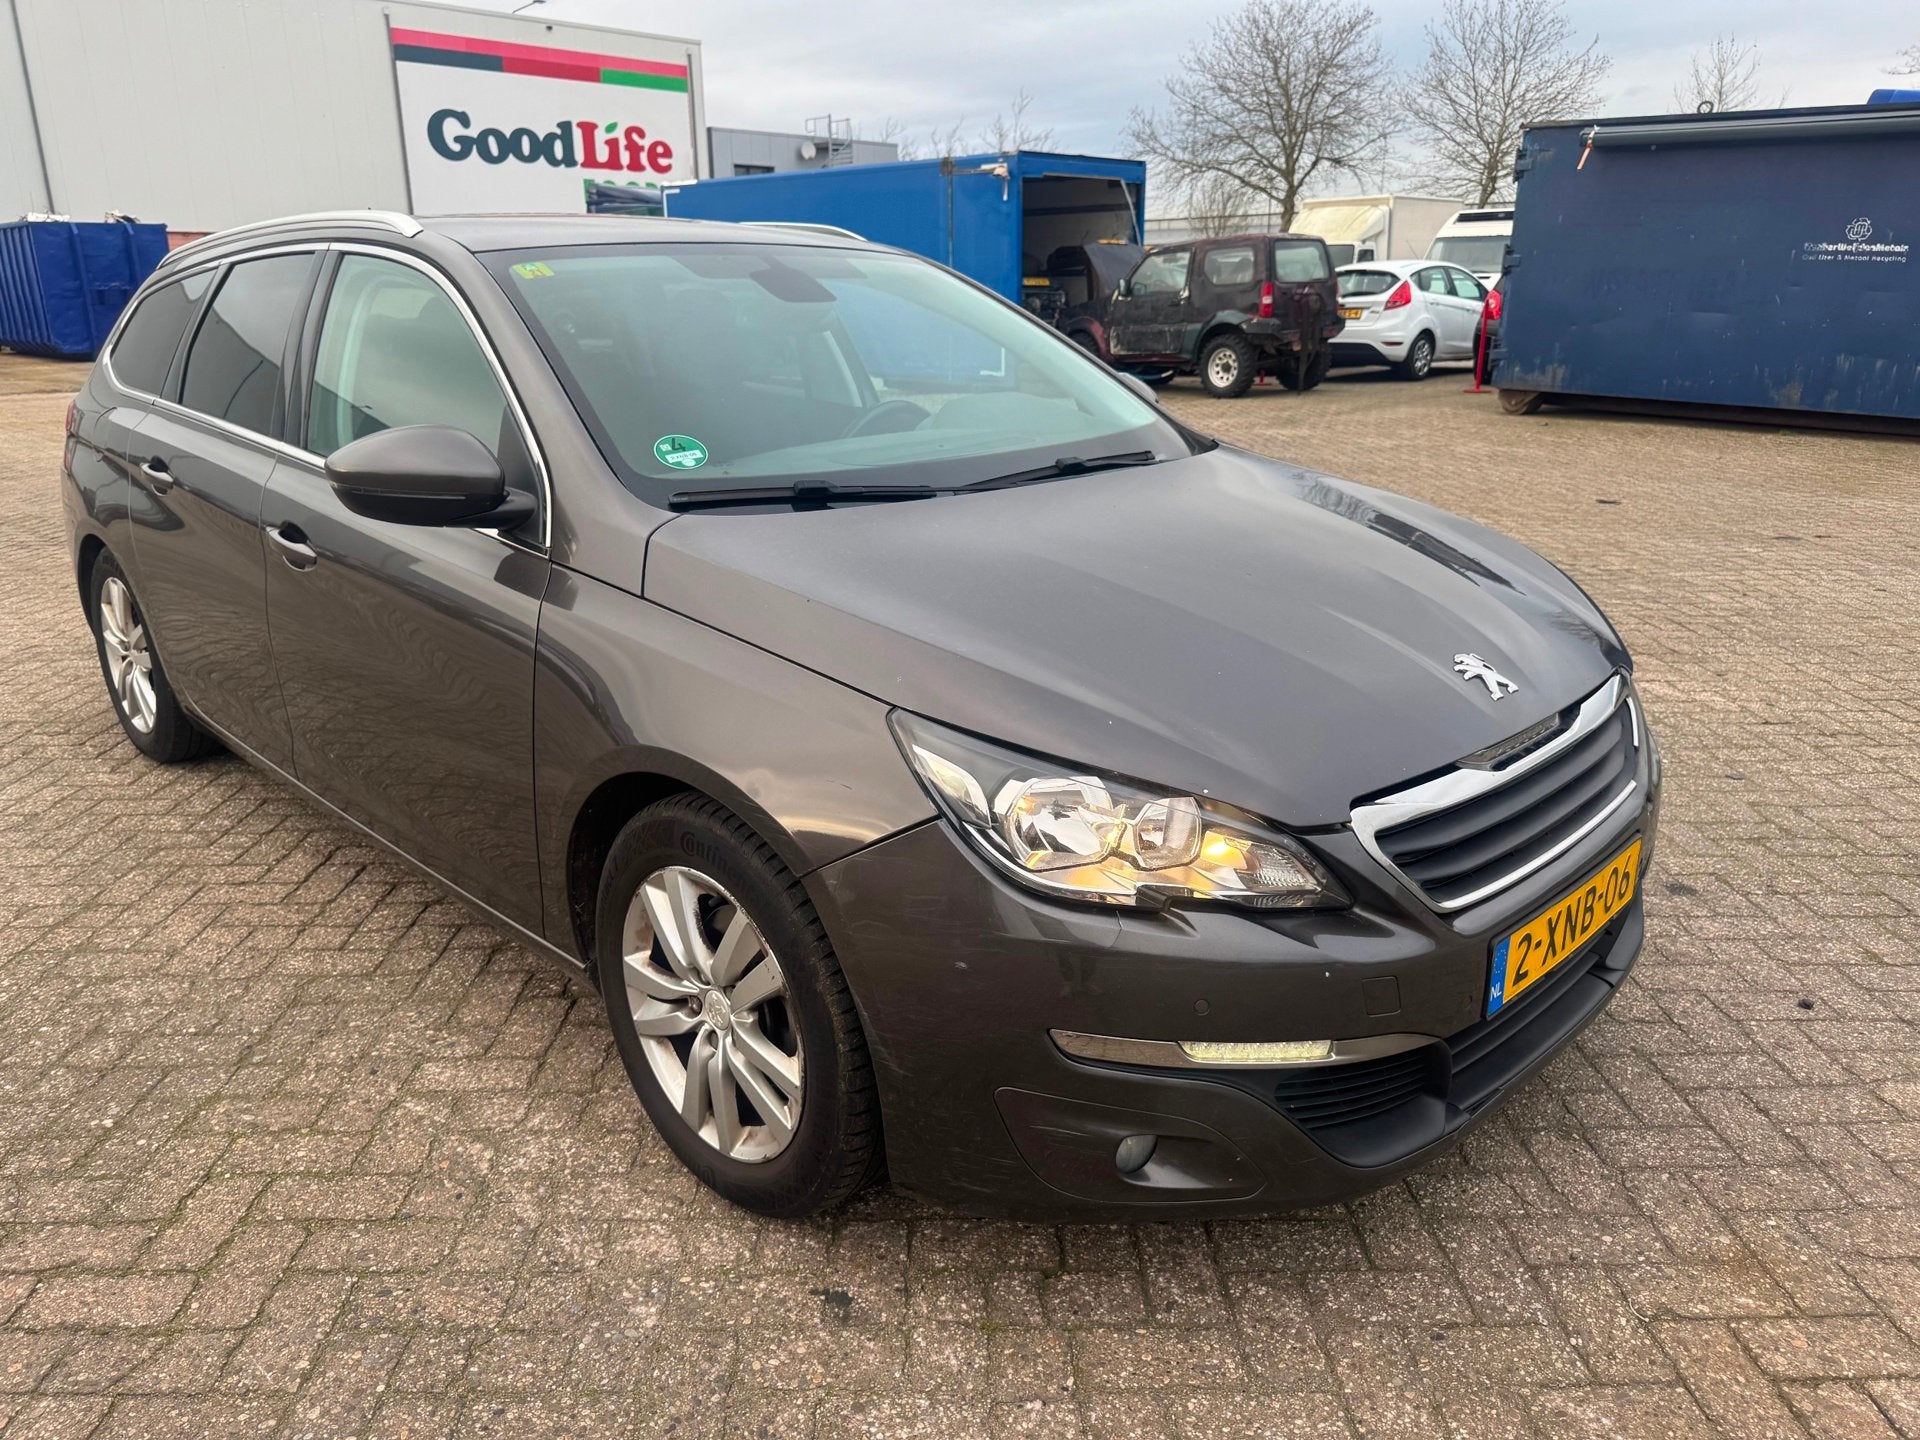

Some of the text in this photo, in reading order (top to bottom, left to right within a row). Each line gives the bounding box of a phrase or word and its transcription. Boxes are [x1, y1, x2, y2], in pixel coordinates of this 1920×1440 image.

[427, 108, 673, 174] GoodLife
[1512, 854, 1631, 987] 2-XNB-06
[1490, 985, 1502, 1001] NL
